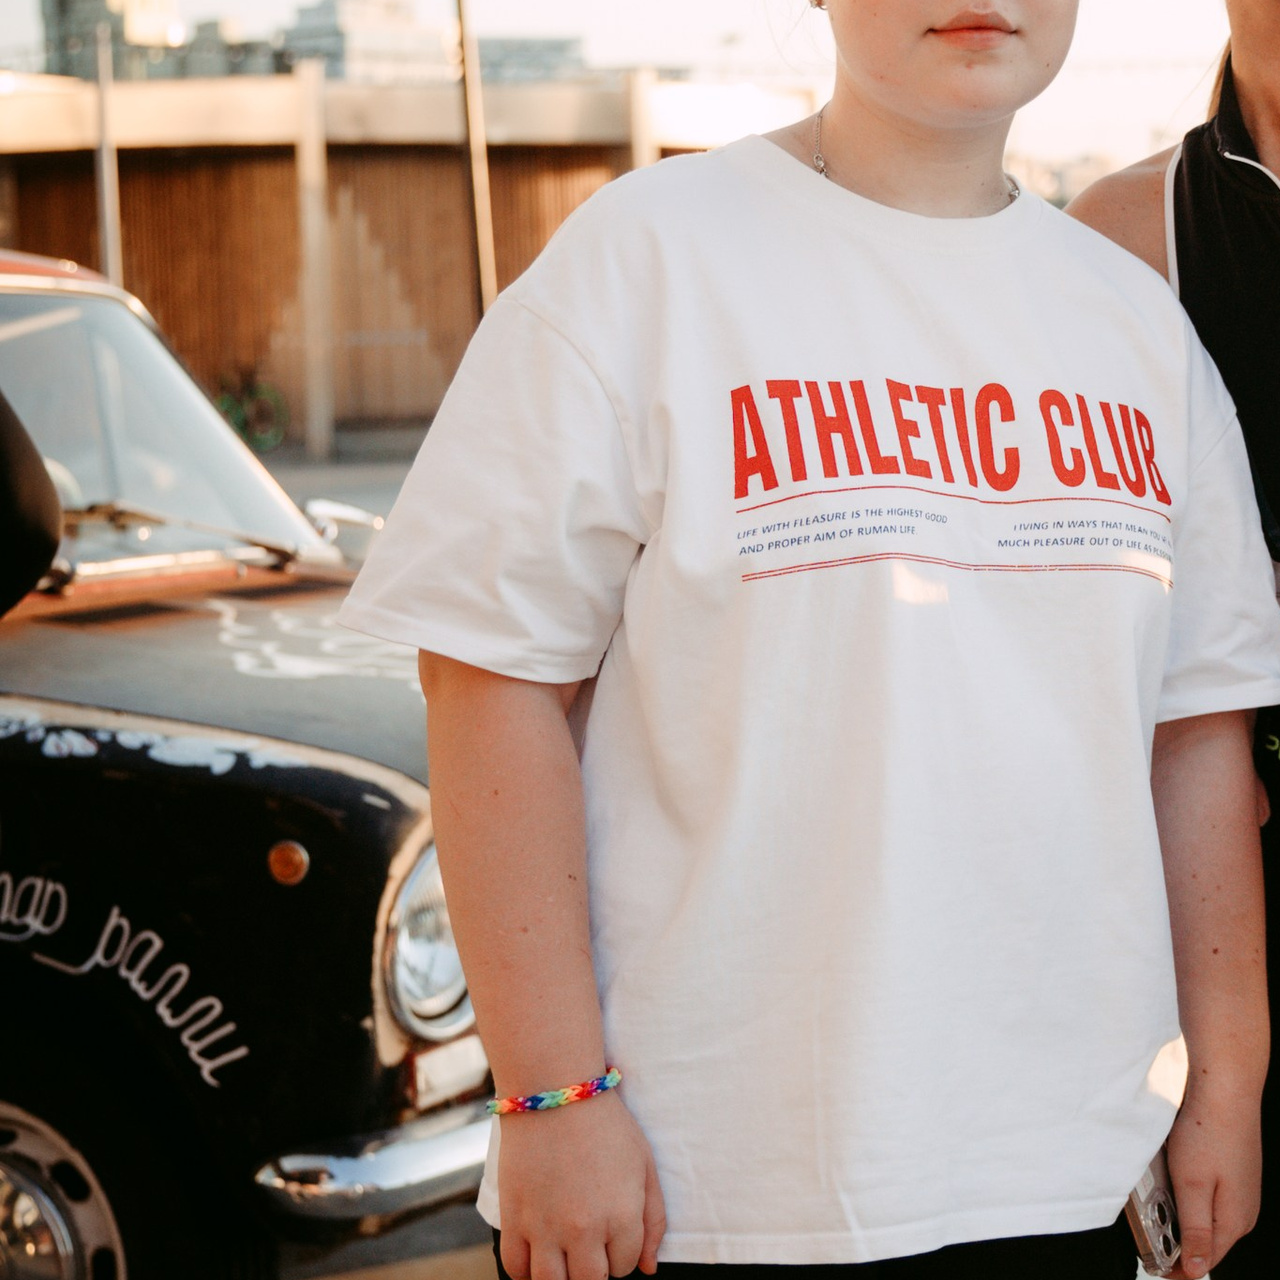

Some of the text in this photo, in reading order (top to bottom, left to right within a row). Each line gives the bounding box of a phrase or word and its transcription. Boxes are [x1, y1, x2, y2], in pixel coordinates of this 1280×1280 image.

[730, 377, 1172, 506] ATHLETIC CLUB
[736, 527, 759, 540] LIFE
[762, 521, 790, 535] WITH
[851, 510, 861, 519] IS
[865, 508, 884, 517] THE
[886, 507, 923, 519] HIGHEST
[924, 511, 948, 524] GOOD
[1052, 520, 1064, 529] IN
[1067, 520, 1098, 529] WAYS
[1101, 520, 1123, 530] THAT
[1125, 523, 1149, 535] MEAN
[1149, 529, 1161, 542] YOU
[738, 543, 764, 556] AND
[767, 535, 811, 551] PROPER
[813, 531, 836, 543] AIM
[839, 528, 854, 539] OF
[997, 537, 1153, 554] MUCH PLEASURE OUT OF LIFE AS
